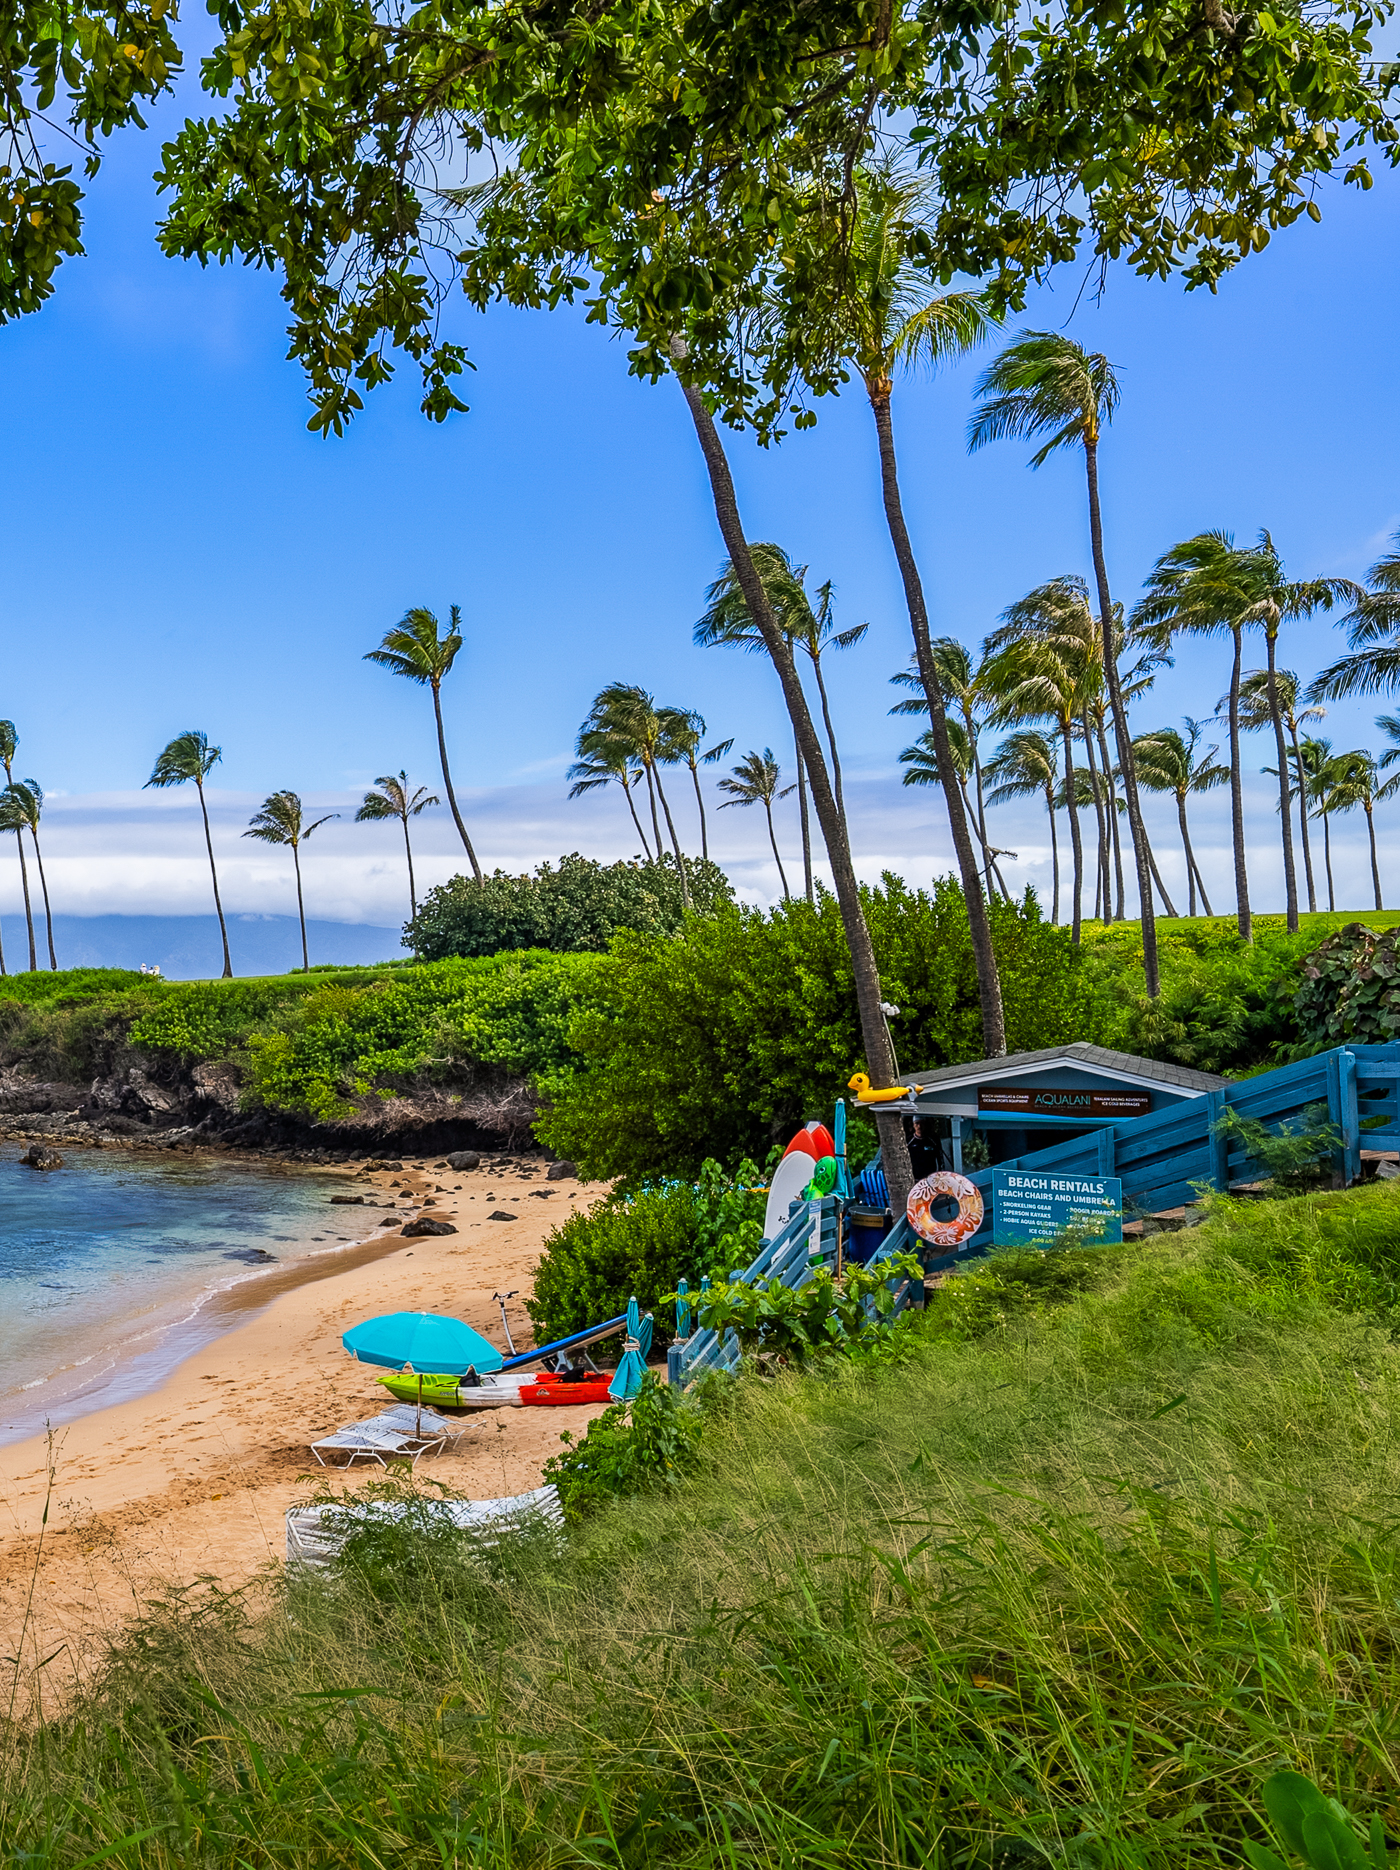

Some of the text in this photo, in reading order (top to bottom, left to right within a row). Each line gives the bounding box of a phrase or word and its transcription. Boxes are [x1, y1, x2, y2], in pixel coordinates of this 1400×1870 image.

[1035, 1093, 1091, 1105] AQUALANI
[1008, 1176, 1104, 1194] BEACH RENTALS
[998, 1189, 1116, 1206] BEACH CHAIRS AND UMBRELLA
[1003, 1201, 1036, 1210] SNORKELING
[1003, 1209, 1051, 1219] 2-PERSON KAYAKS
[1036, 1220, 1059, 1228] GLIDERS
